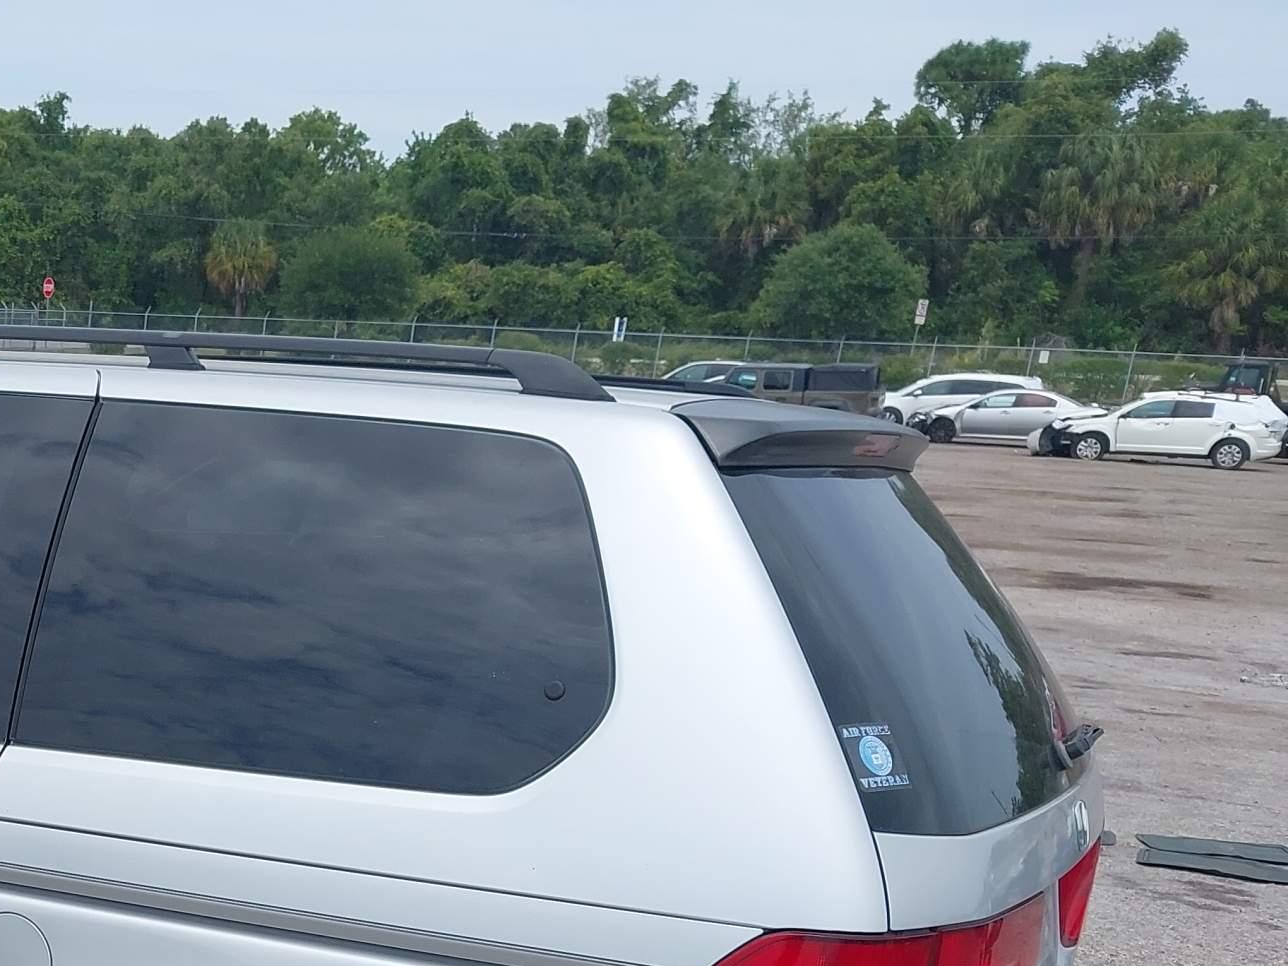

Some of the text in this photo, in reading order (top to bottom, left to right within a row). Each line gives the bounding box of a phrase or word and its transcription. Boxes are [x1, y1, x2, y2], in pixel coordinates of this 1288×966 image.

[842, 724, 891, 738] AIR FORCE
[859, 774, 910, 789] VETERAN
